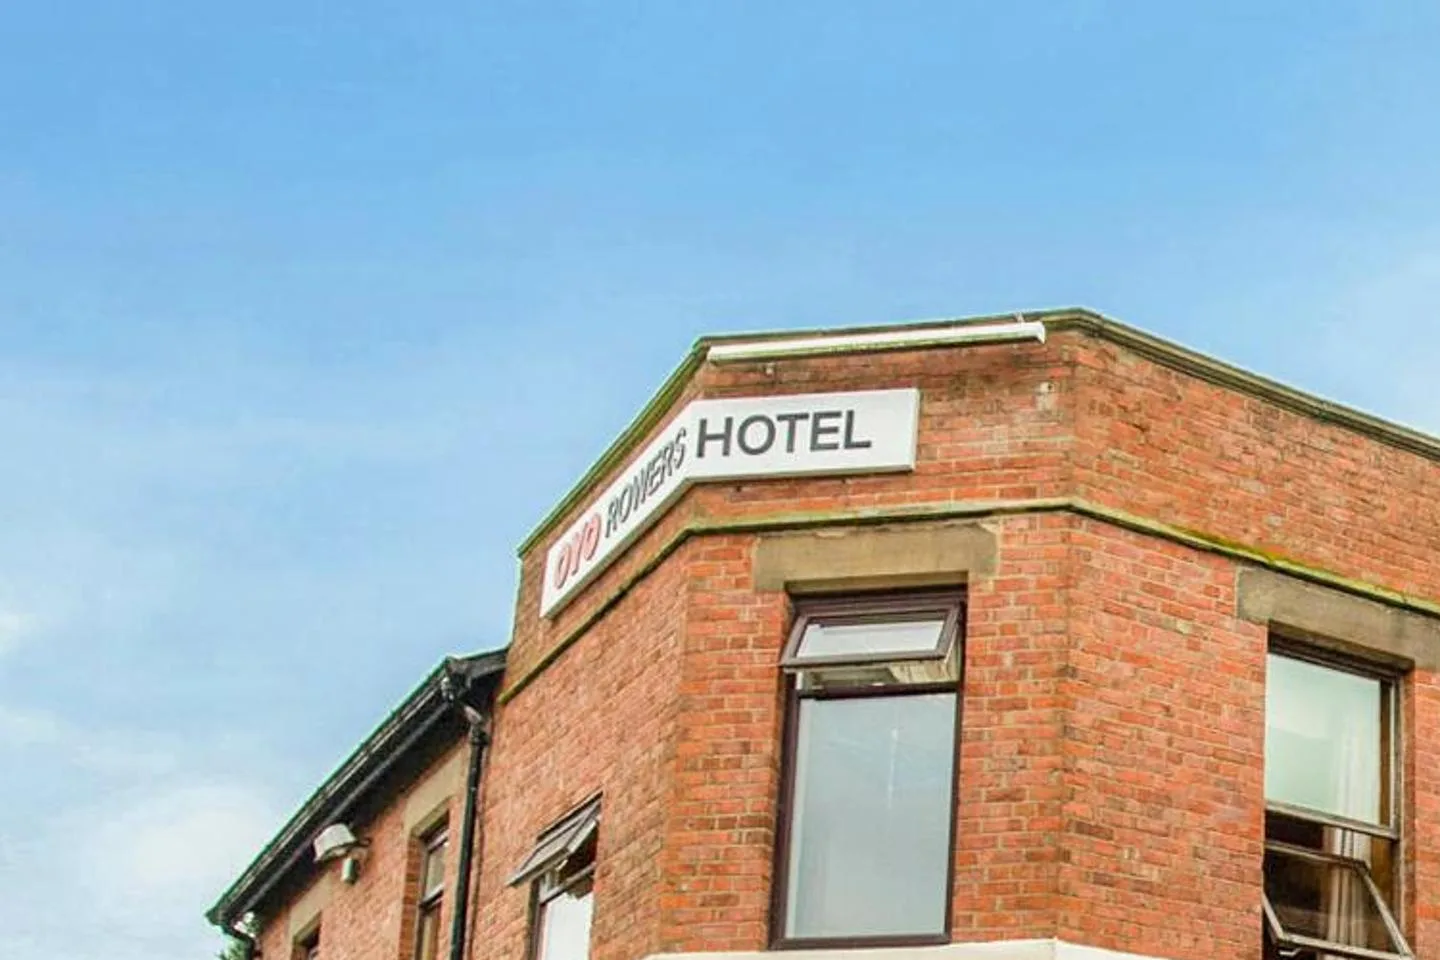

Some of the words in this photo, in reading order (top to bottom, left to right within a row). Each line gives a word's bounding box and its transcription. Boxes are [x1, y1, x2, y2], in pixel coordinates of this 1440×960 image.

[554, 513, 602, 590] OYO
[605, 427, 687, 539] ROWERS
[696, 409, 872, 459] HOTEL
